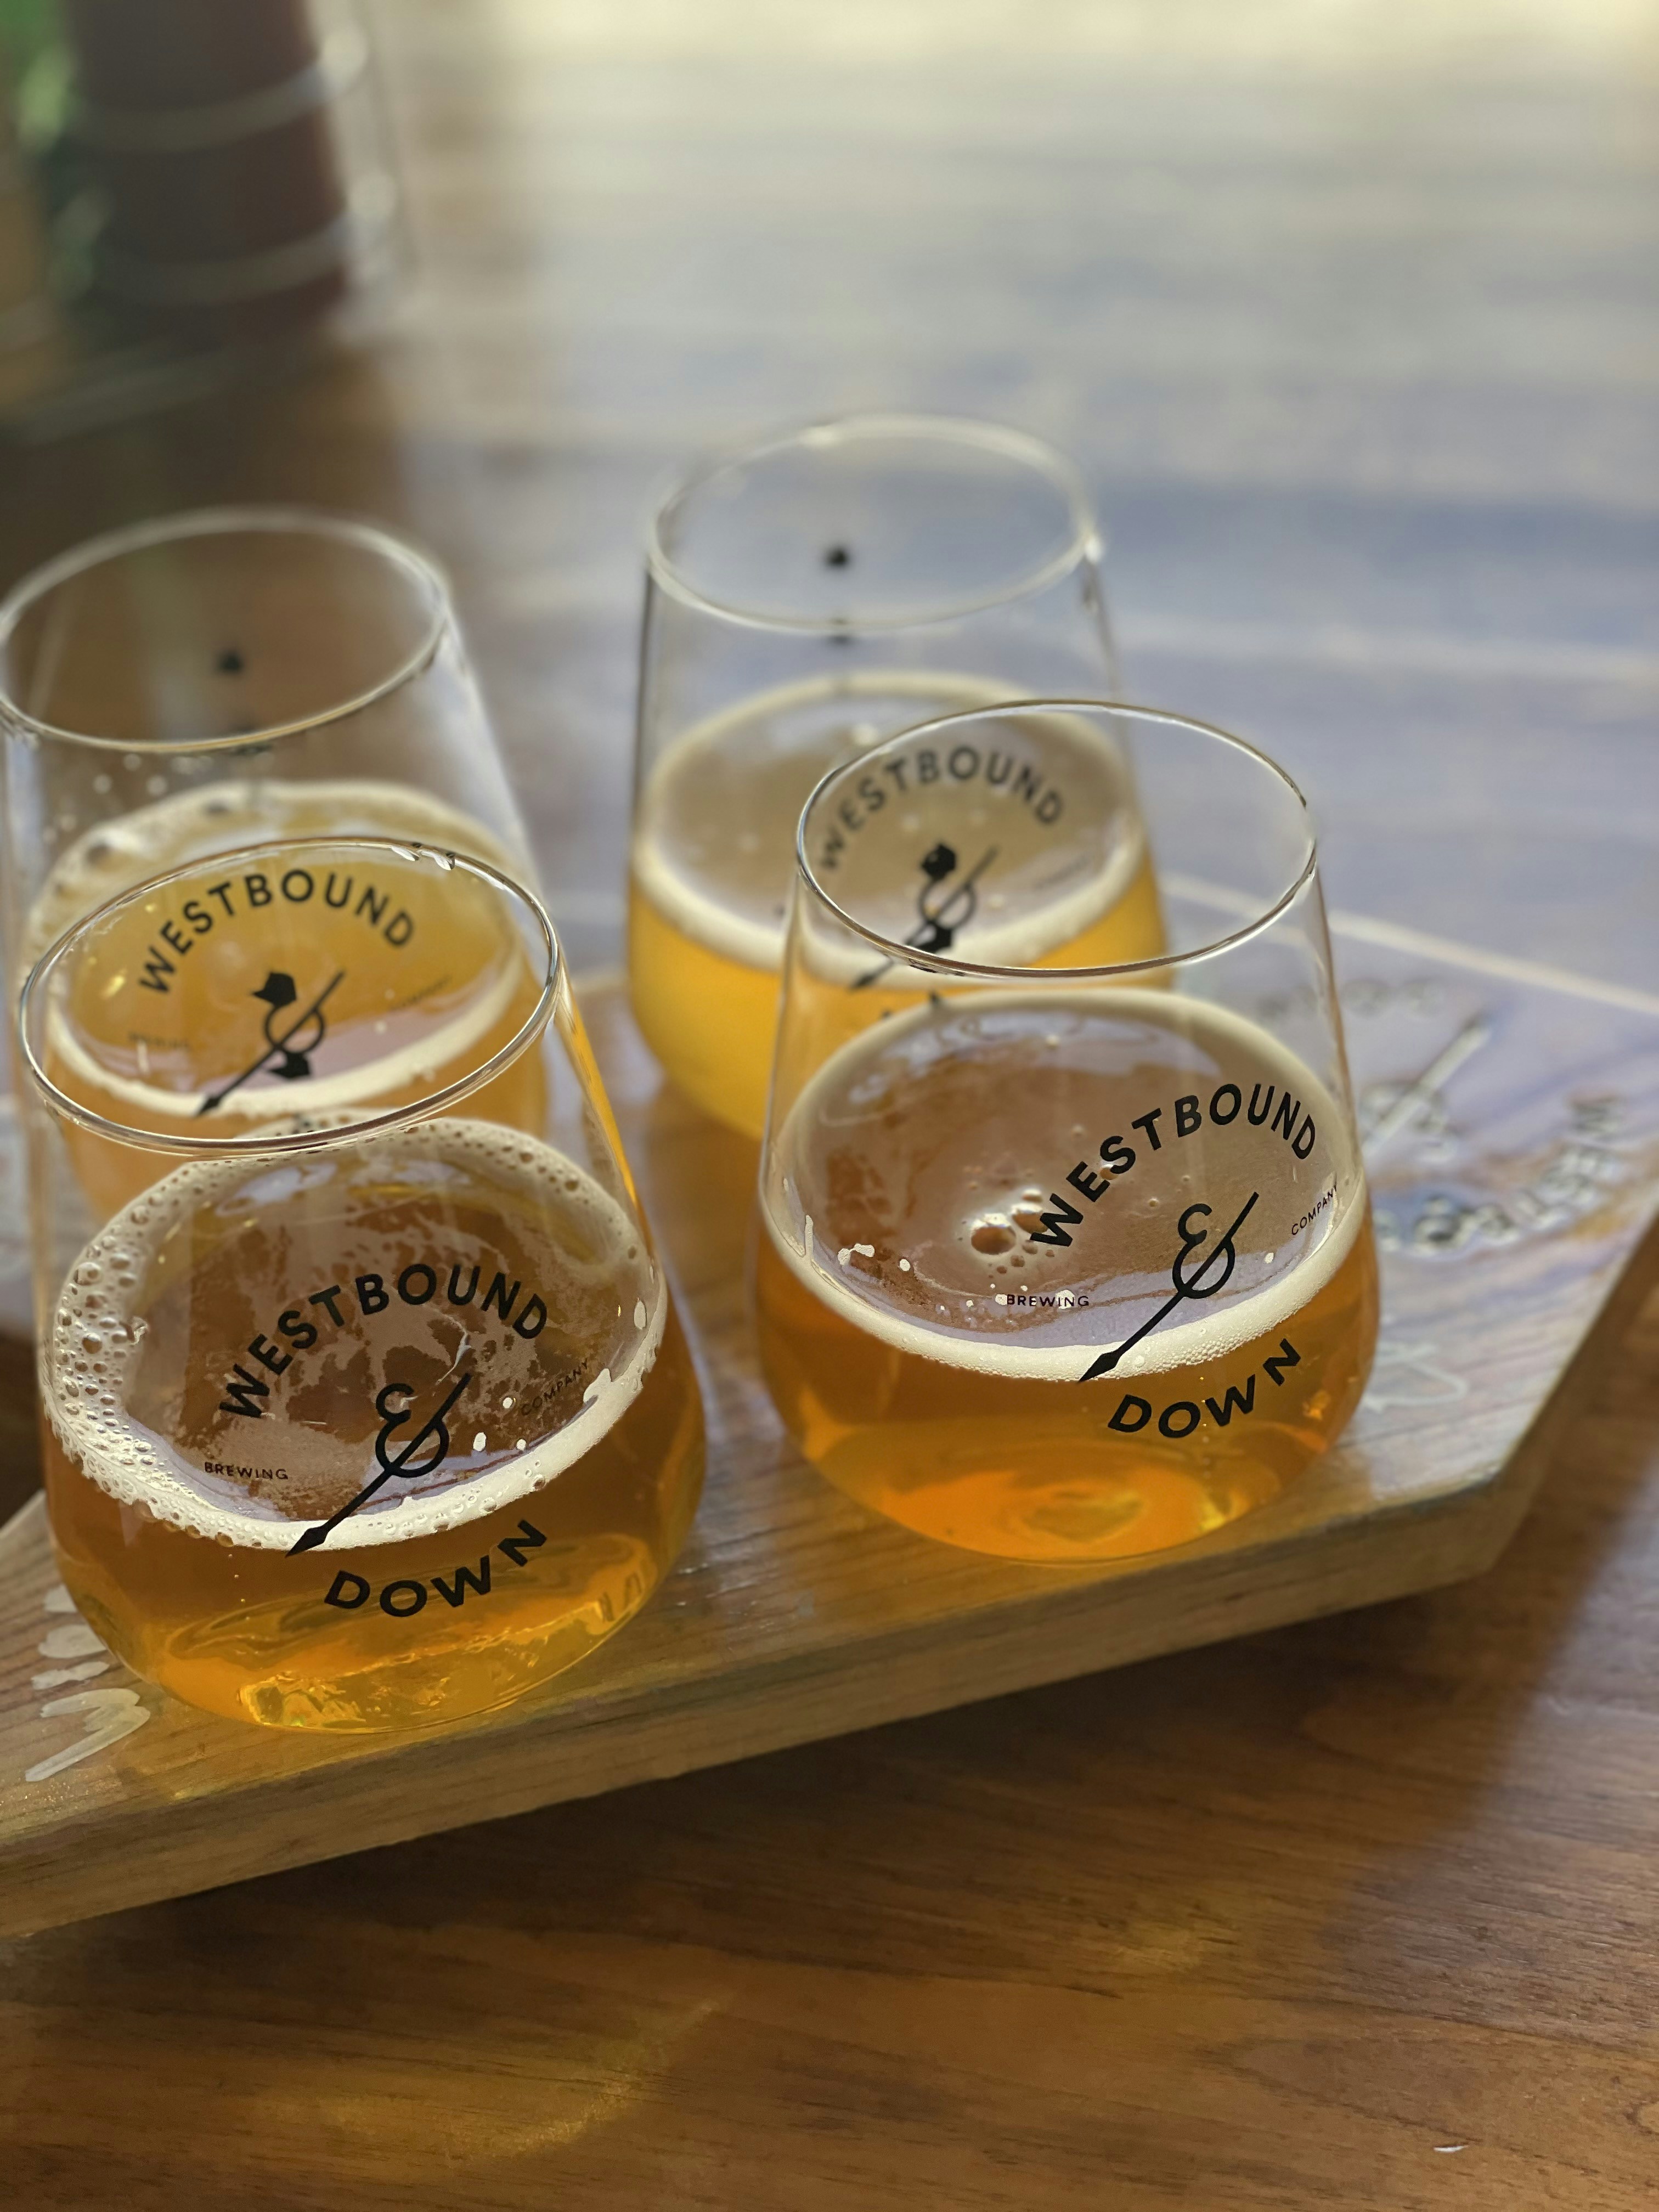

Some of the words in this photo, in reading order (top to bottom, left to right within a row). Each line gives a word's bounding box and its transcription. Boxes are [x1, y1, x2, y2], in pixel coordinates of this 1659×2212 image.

[821, 745, 1064, 870] WESTBOUND
[139, 868, 414, 994] WESTBOUND
[1028, 1084, 1316, 1248] WESTBOUND
[1291, 1182, 1337, 1235] COMPANY
[218, 1263, 548, 1419] WESTBOUND
[1006, 1293, 1090, 1308] BREWING
[521, 1358, 588, 1416] COMPANY
[1107, 1338, 1301, 1438] DOWN
[204, 1461, 289, 1481] BREWING
[324, 1519, 548, 1618] DOWN
